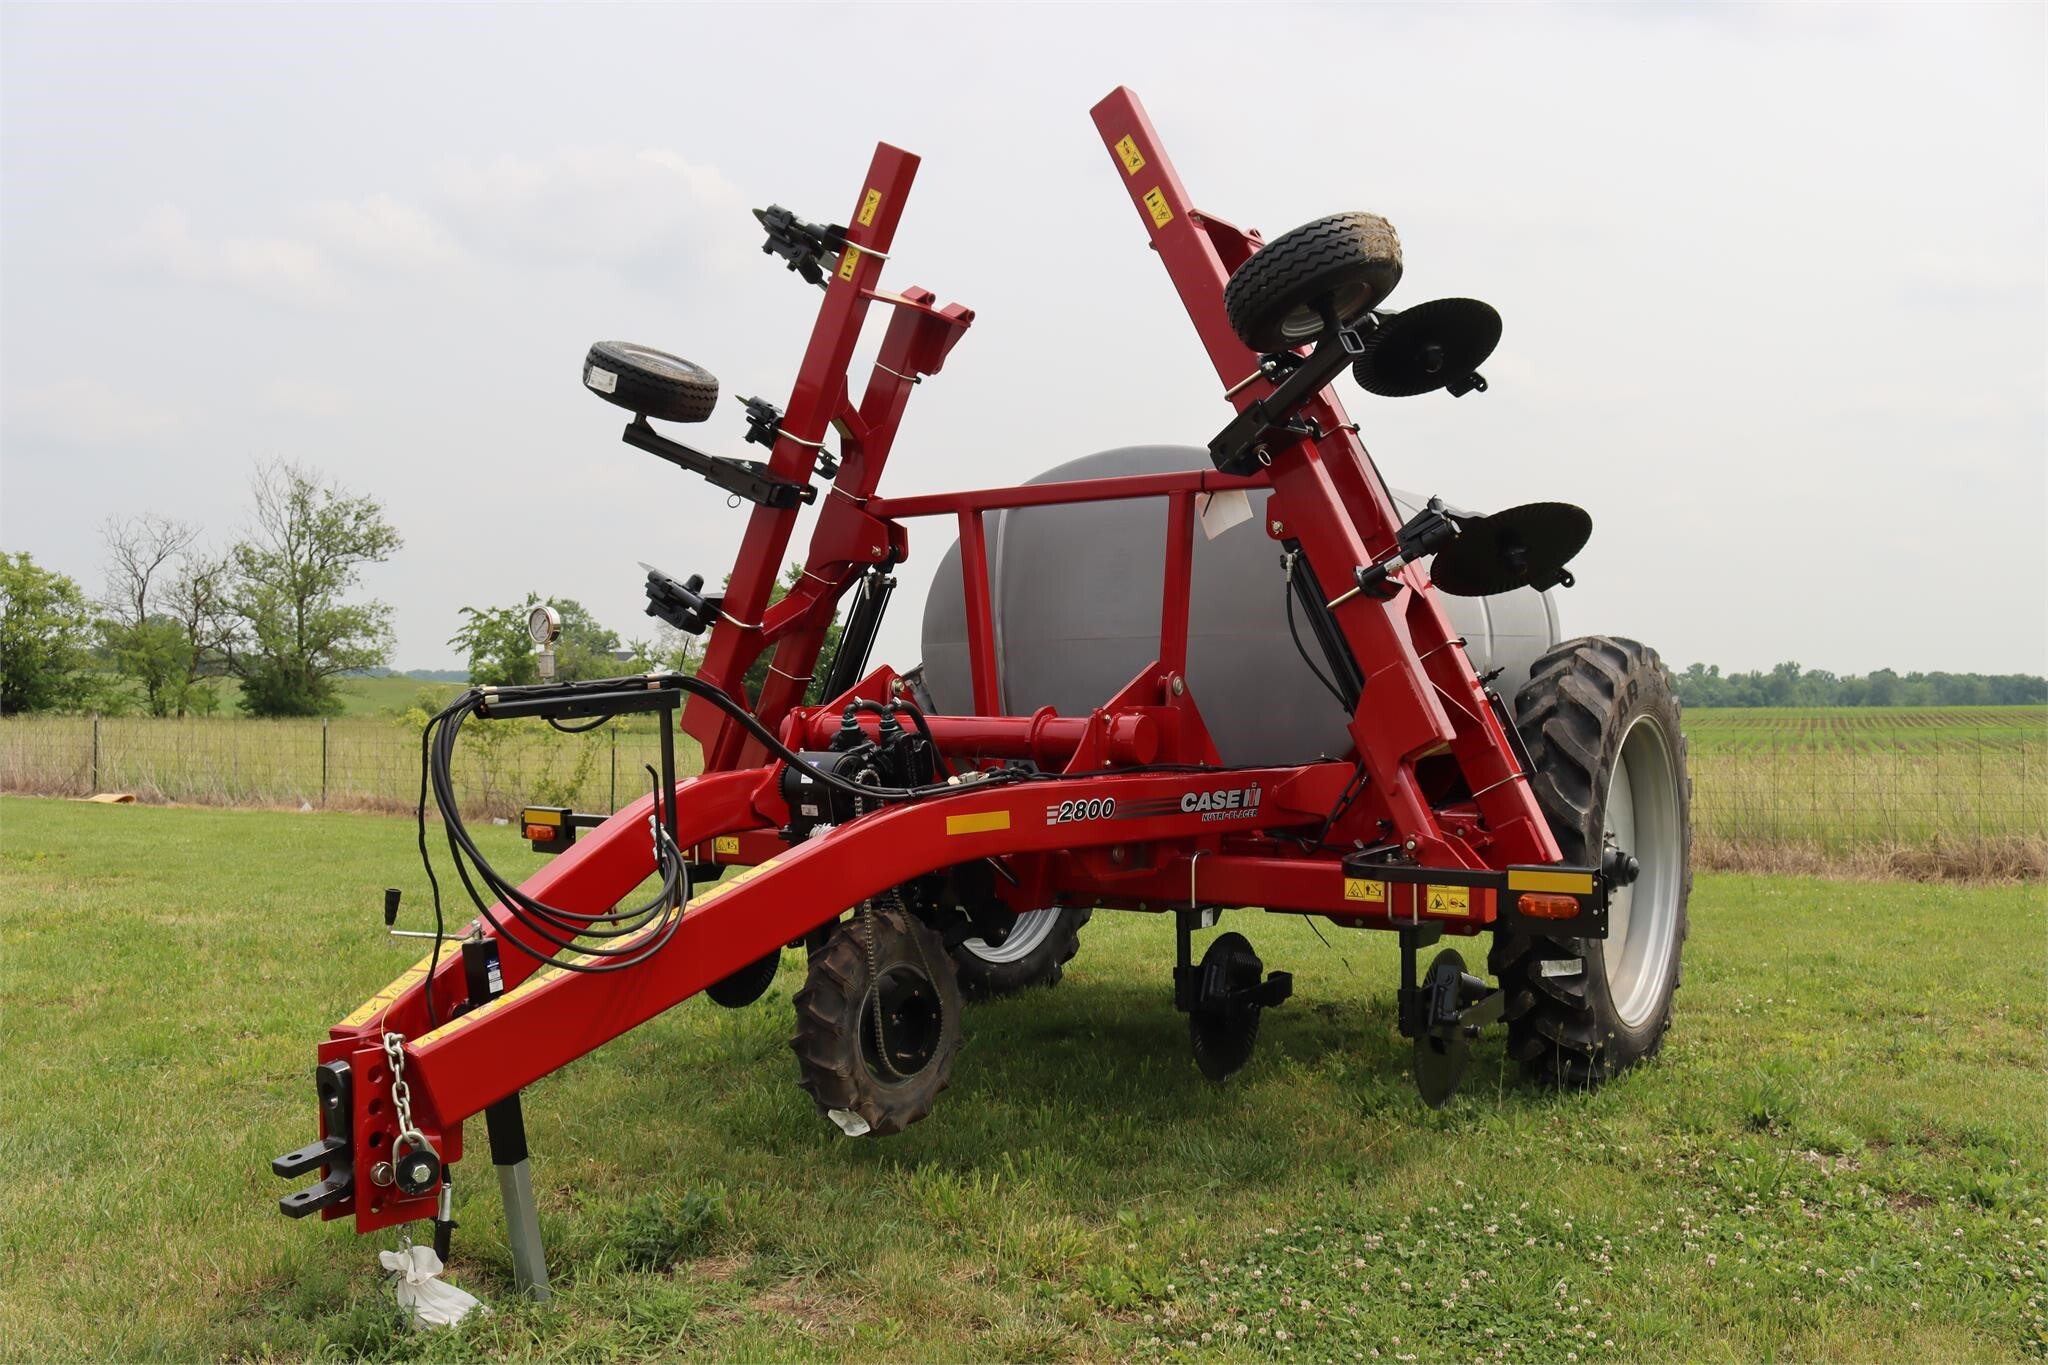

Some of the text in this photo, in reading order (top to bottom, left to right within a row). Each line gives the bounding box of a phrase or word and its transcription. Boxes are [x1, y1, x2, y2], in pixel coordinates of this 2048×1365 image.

[1058, 797, 1115, 823] 2800
[1180, 789, 1241, 812] CASE
[1202, 809, 1258, 822] NUTRI-PLACER
